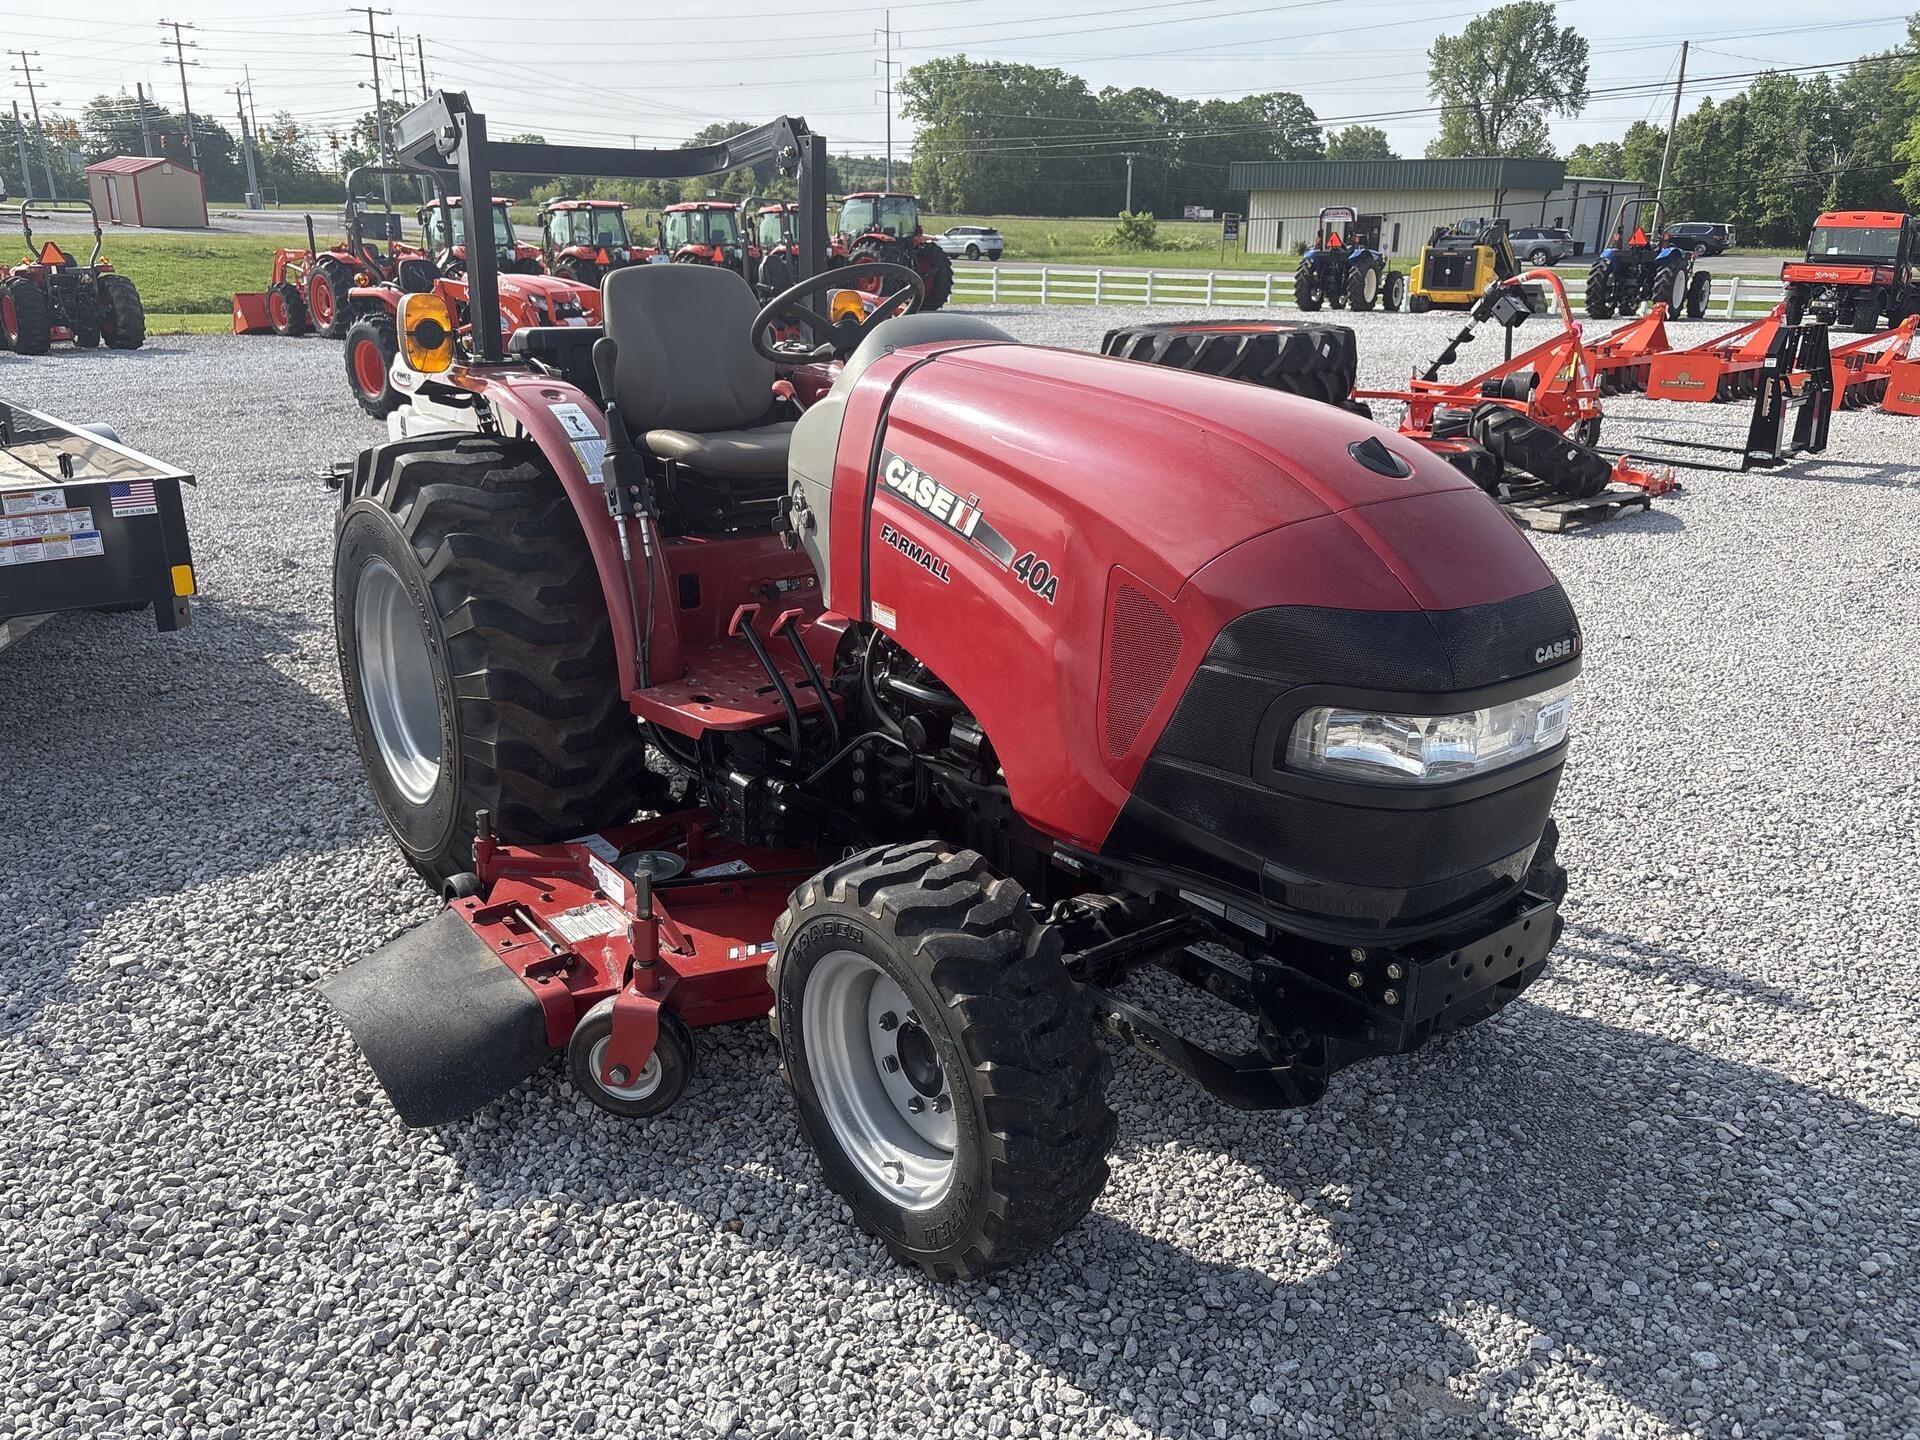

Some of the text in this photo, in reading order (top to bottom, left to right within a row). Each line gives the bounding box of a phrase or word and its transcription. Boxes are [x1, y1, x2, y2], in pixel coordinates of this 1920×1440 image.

[885, 457, 956, 521] CASE
[879, 523, 951, 584] FARMALL
[1013, 551, 1059, 605] 40A
[1535, 639, 1571, 663] CASE
[792, 920, 864, 967] LOADER
